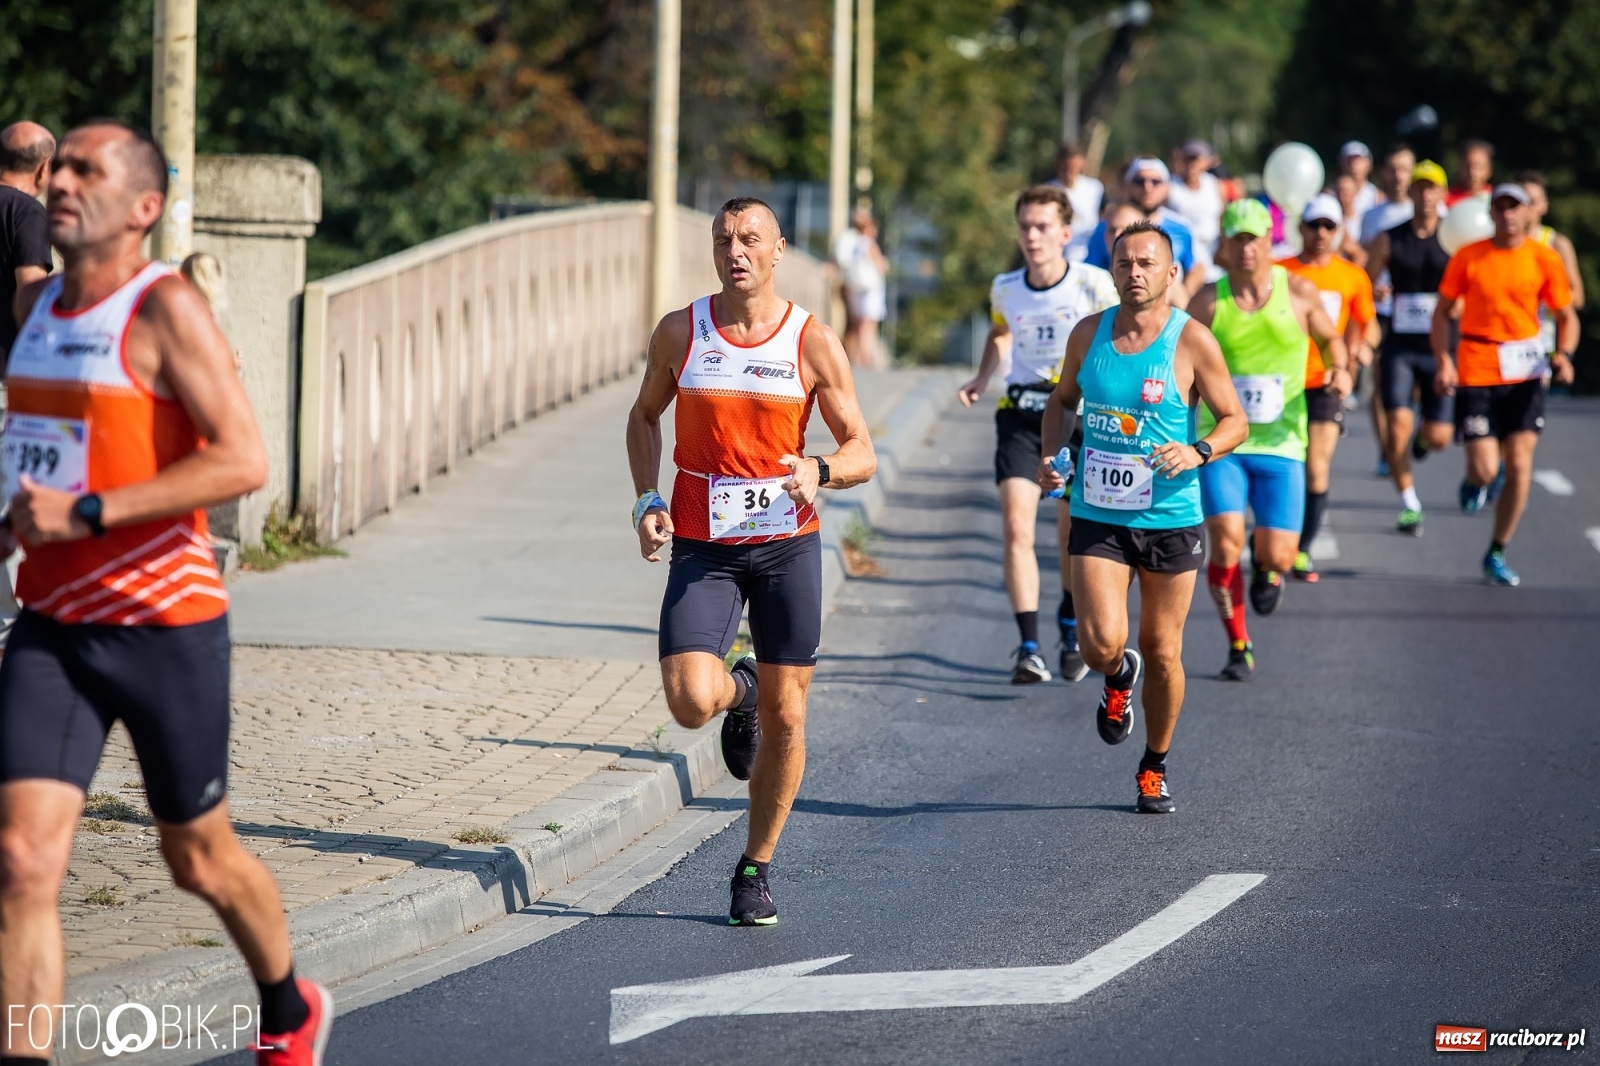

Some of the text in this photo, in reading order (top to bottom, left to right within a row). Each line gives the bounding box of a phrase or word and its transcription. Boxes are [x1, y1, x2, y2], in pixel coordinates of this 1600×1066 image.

[698, 318, 711, 343] deep
[703, 356, 723, 364] PGE
[742, 365, 796, 379] FENIKS
[1087, 412, 1144, 436] ensol
[1092, 432, 1151, 449] www.ensol.pl
[18, 443, 59, 476] 399
[1101, 466, 1134, 487] 100
[744, 488, 771, 510] 36
